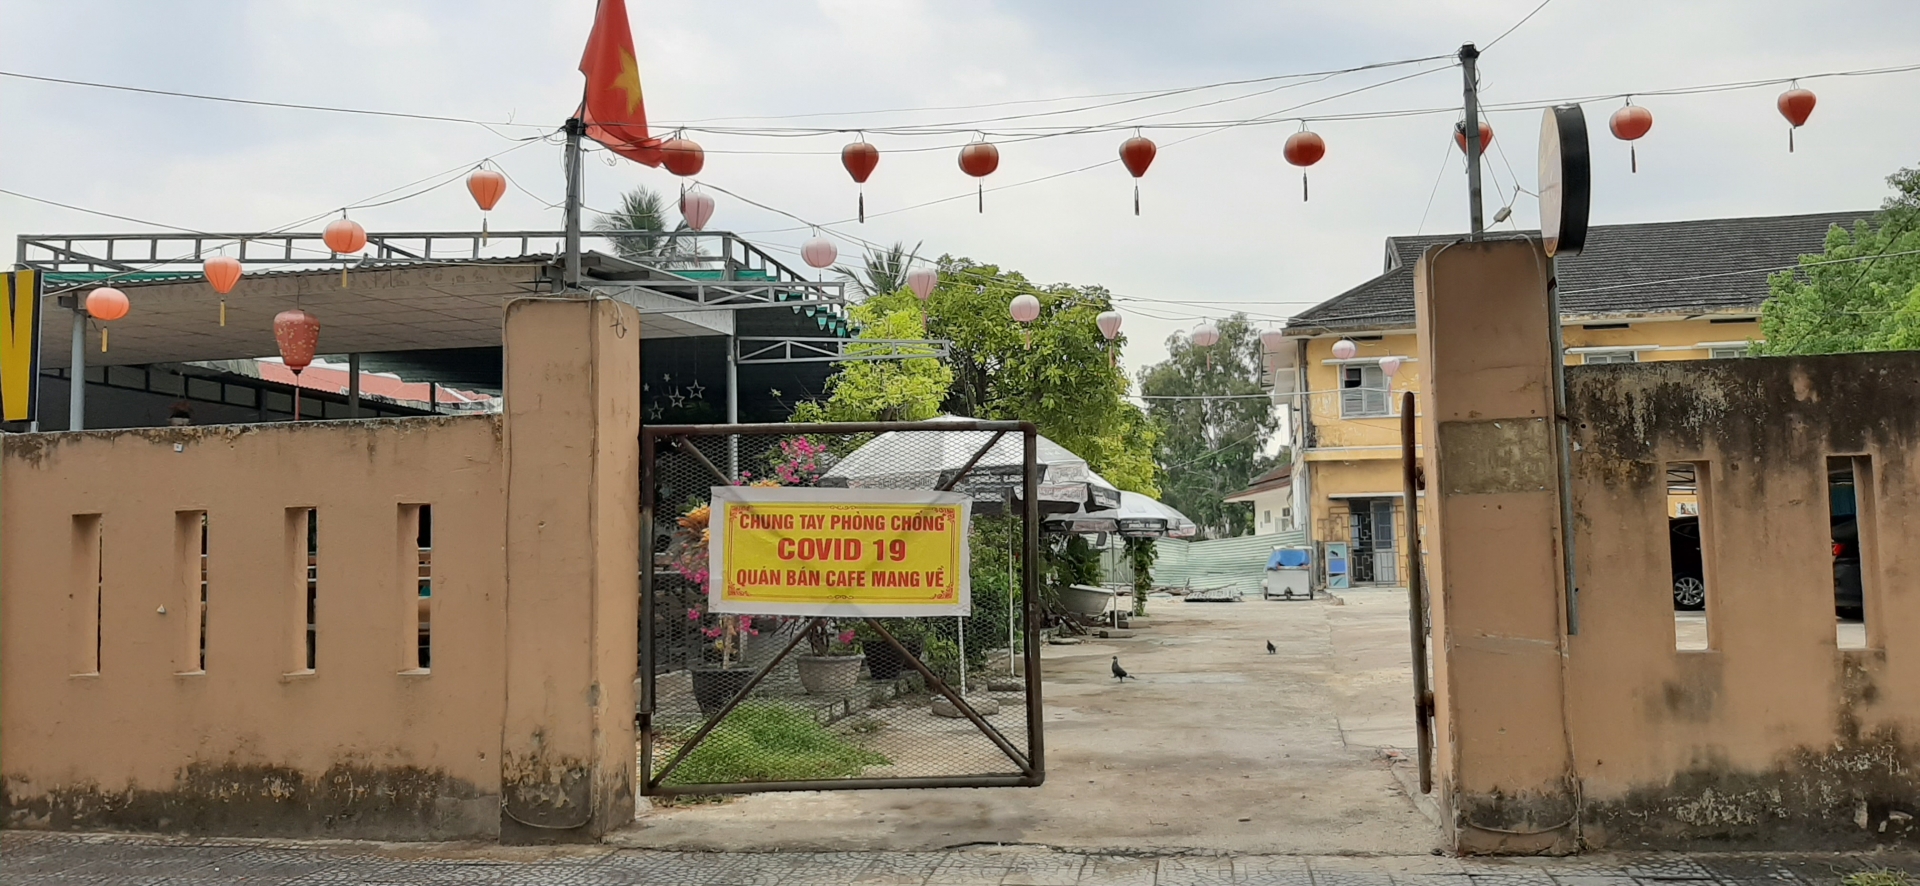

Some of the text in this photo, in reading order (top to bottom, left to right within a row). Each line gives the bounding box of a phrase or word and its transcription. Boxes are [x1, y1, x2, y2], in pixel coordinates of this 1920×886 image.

[739, 510, 945, 532] CHUNG TAY PHÒNG CHỐNG
[777, 537, 907, 562] COVID 19
[736, 565, 944, 588] QUÁN BÁN CAFE MANG VỀ
